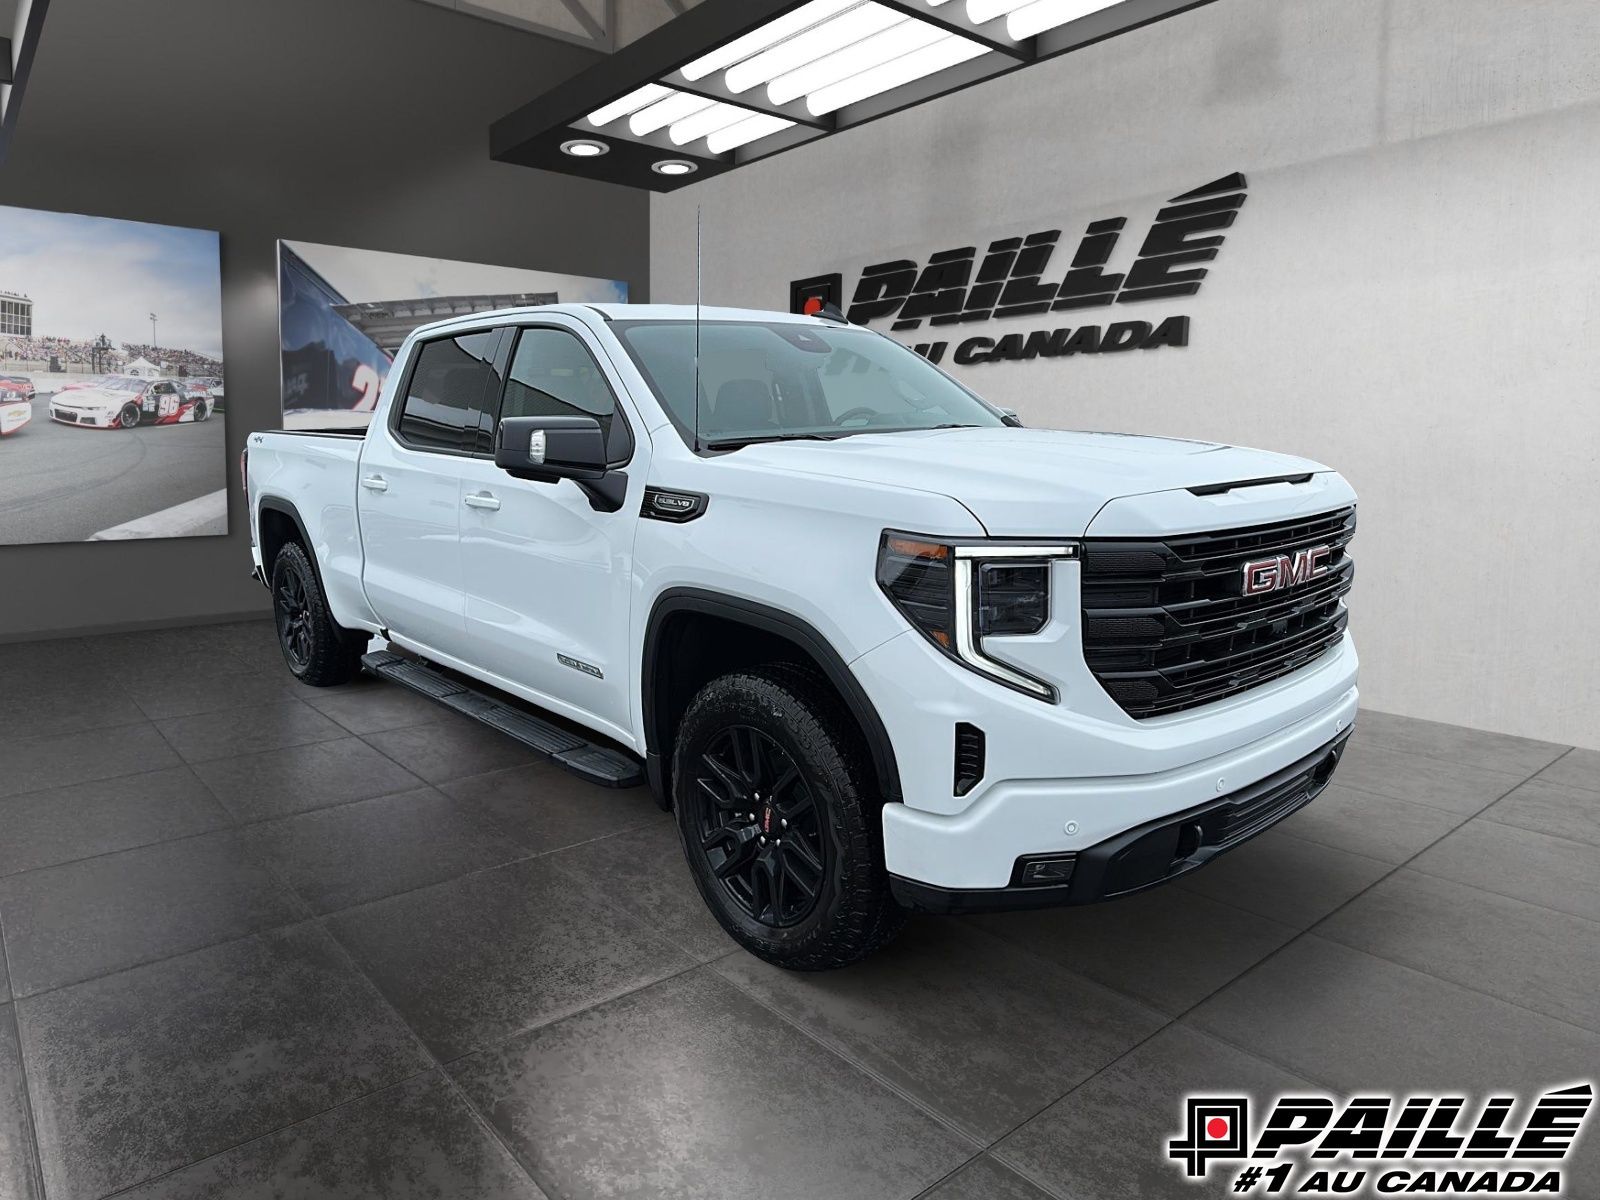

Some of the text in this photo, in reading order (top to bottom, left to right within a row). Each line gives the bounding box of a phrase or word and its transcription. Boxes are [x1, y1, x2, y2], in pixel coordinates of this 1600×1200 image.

[846, 171, 1248, 330] PAILLÉ
[906, 315, 1190, 366] U CANADA
[158, 394, 180, 416] 96
[1242, 545, 1330, 597] GMC
